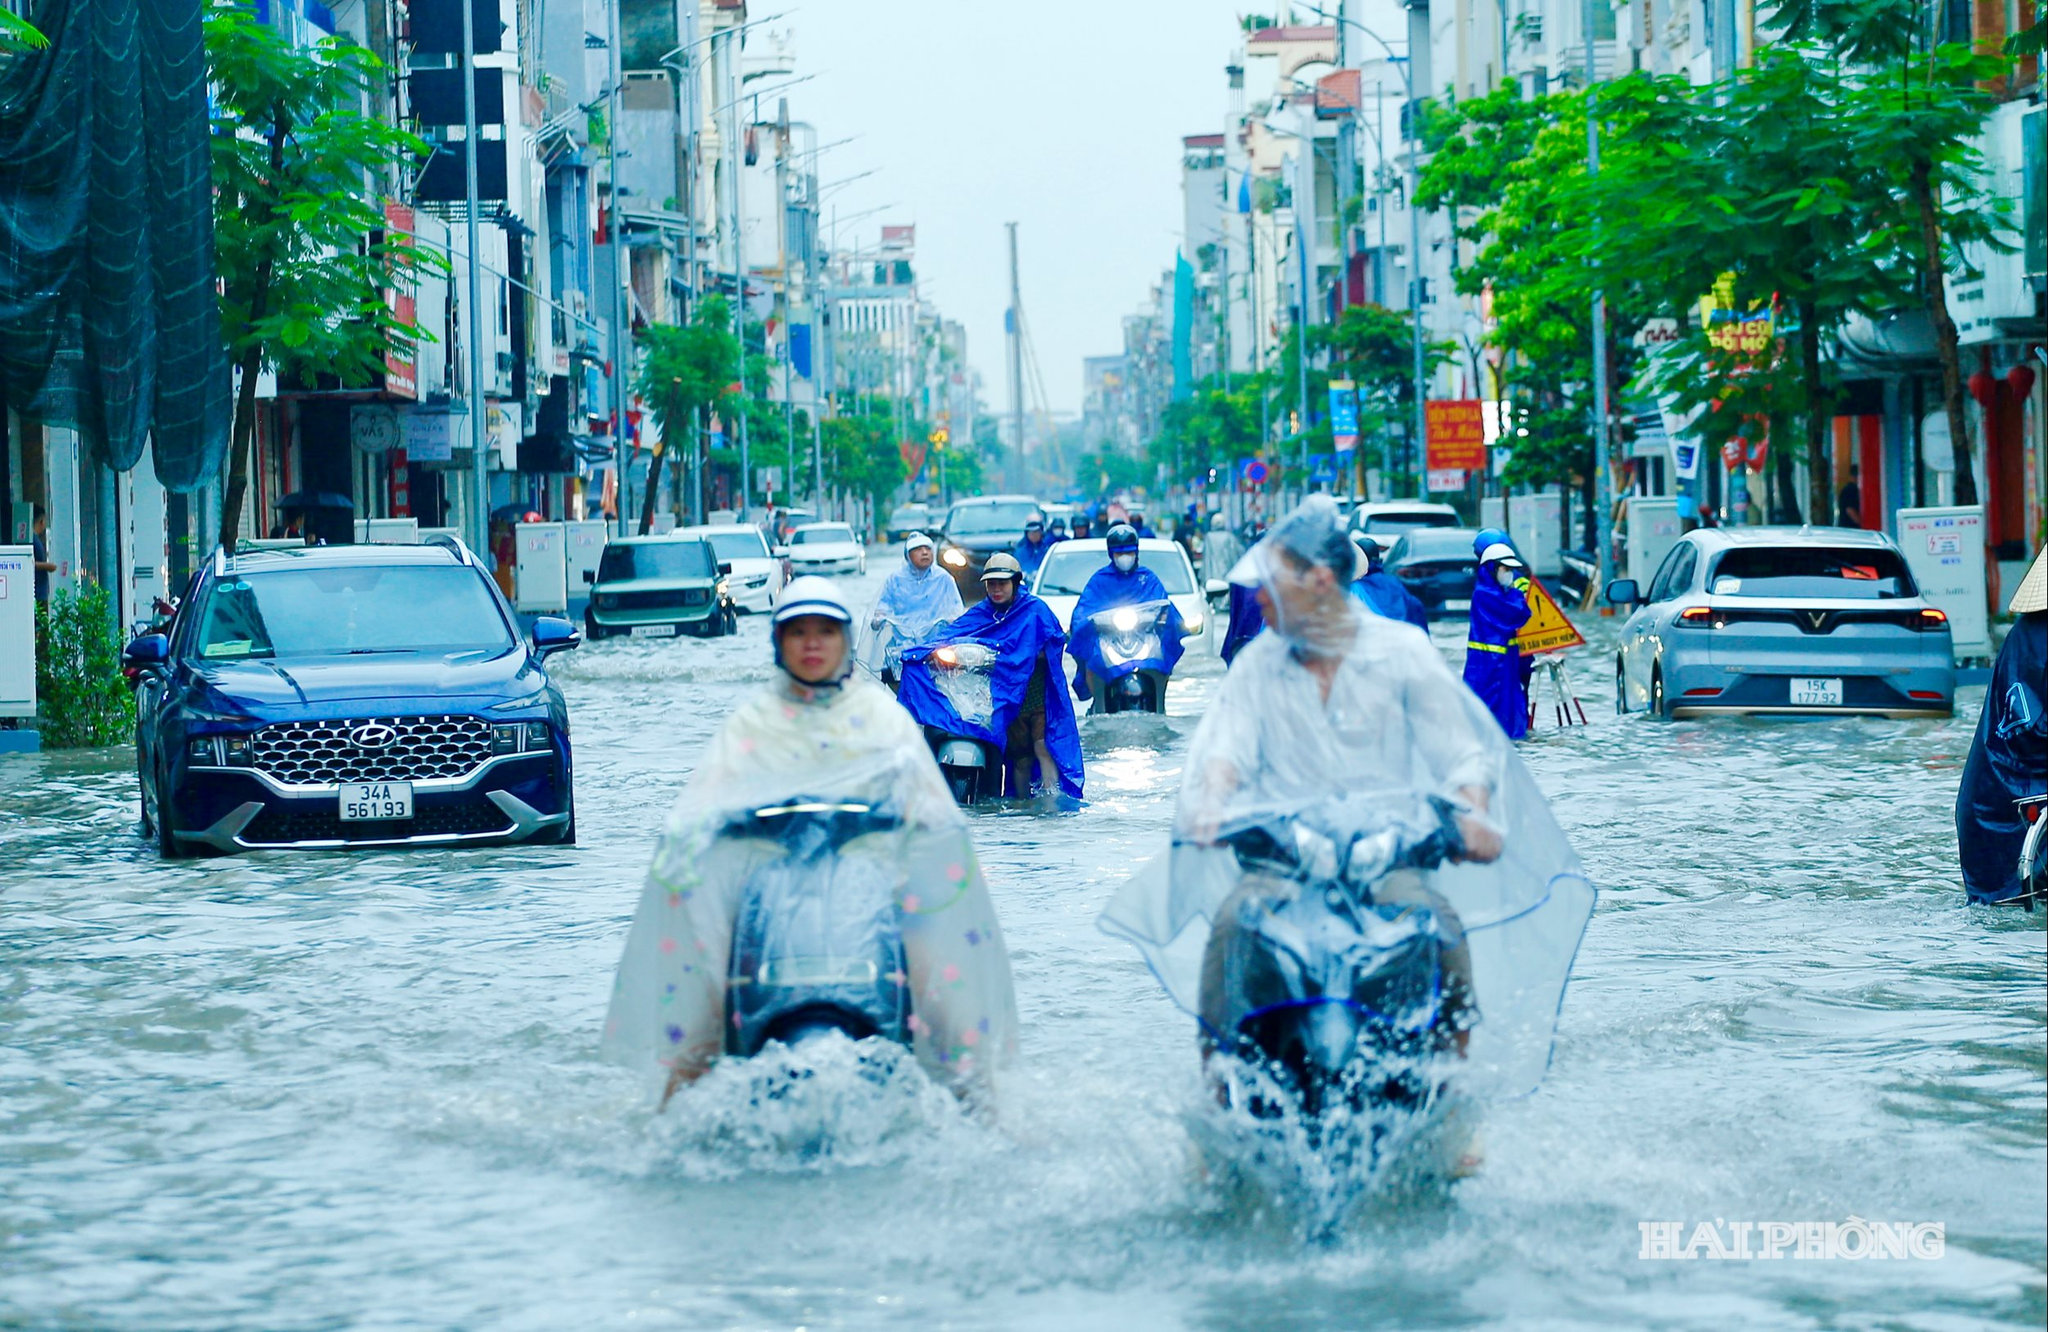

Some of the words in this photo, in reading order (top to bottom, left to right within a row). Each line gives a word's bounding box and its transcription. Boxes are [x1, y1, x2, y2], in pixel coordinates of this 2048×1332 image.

[1807, 680, 1826, 691] 15K
[361, 785, 391, 800] 34A
[347, 801, 405, 818] 561.93
